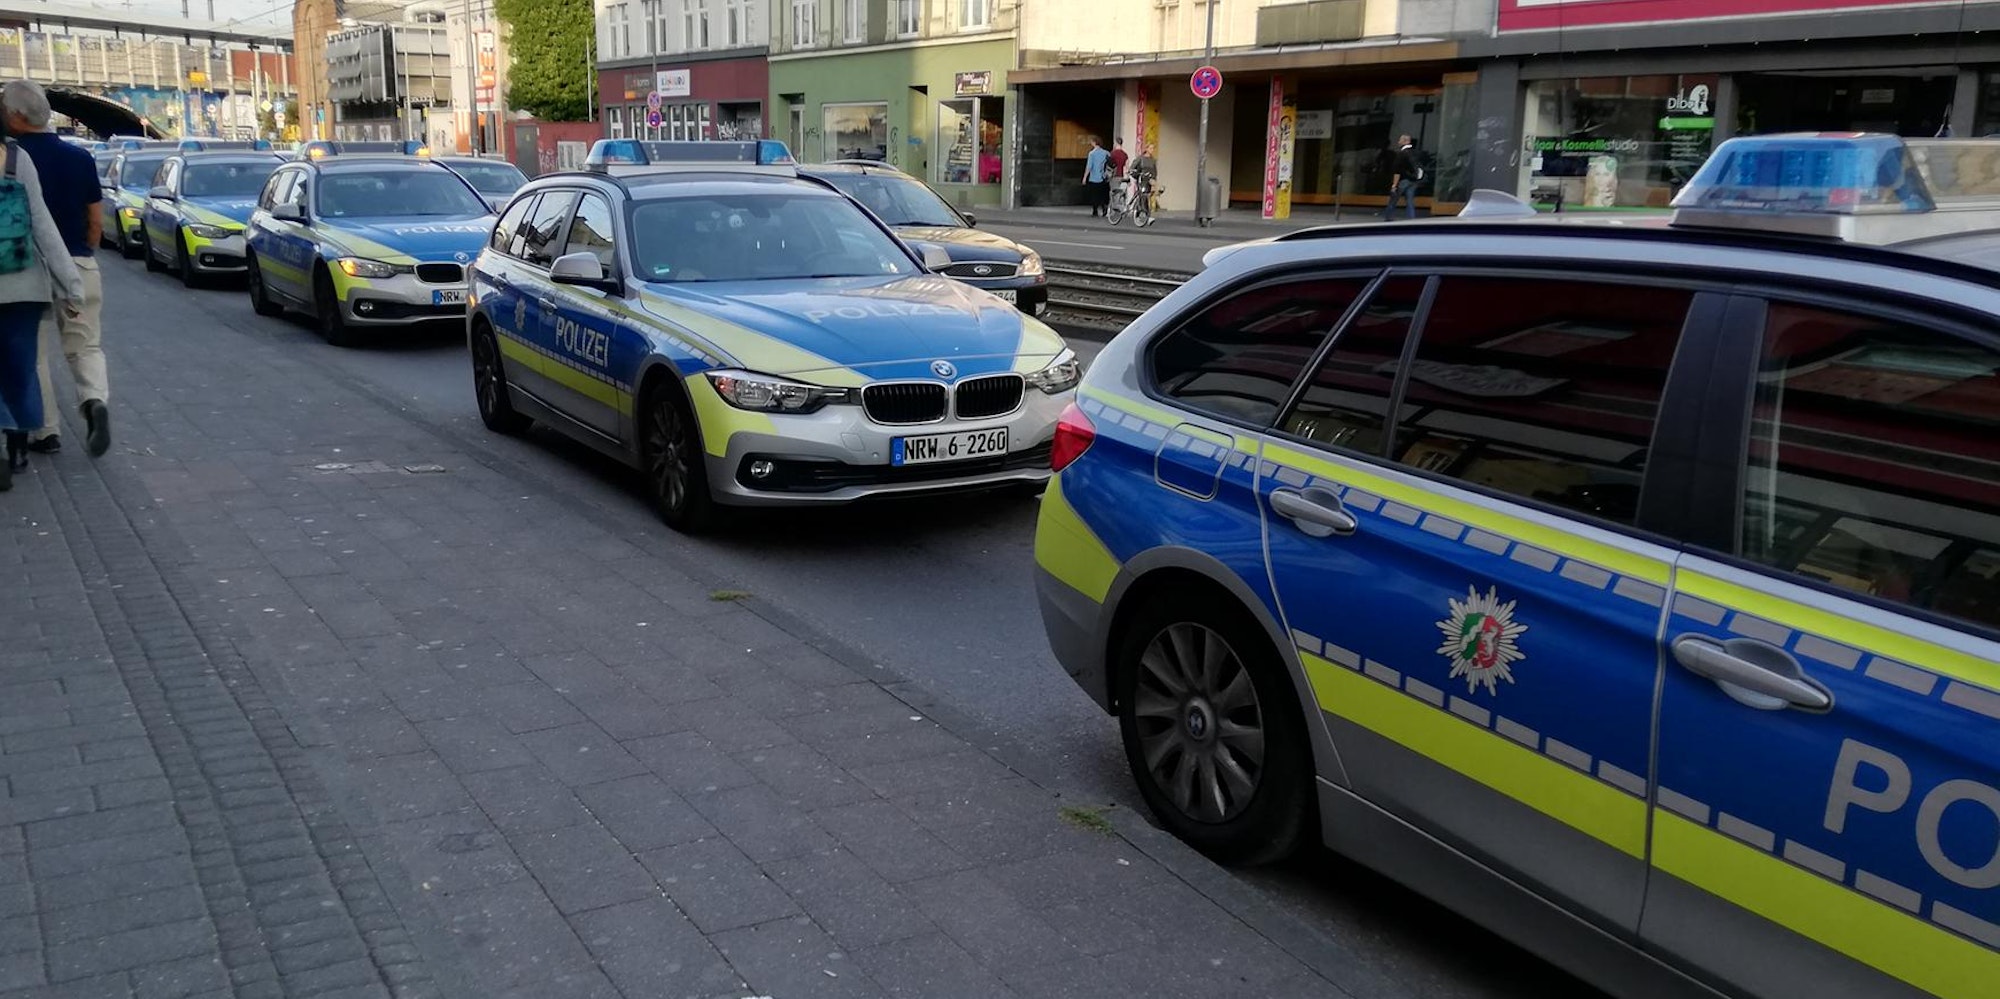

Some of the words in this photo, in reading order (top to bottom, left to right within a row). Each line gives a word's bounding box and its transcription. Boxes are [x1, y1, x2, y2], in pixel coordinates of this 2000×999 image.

[393, 225, 488, 235] POLIZEI
[440, 291, 460, 302] NRW
[803, 303, 971, 324] POLIZEI
[556, 316, 609, 368] POLIZEI
[905, 438, 938, 460] NRW
[948, 431, 1005, 456] 6-2260
[1823, 738, 2000, 889] PO
